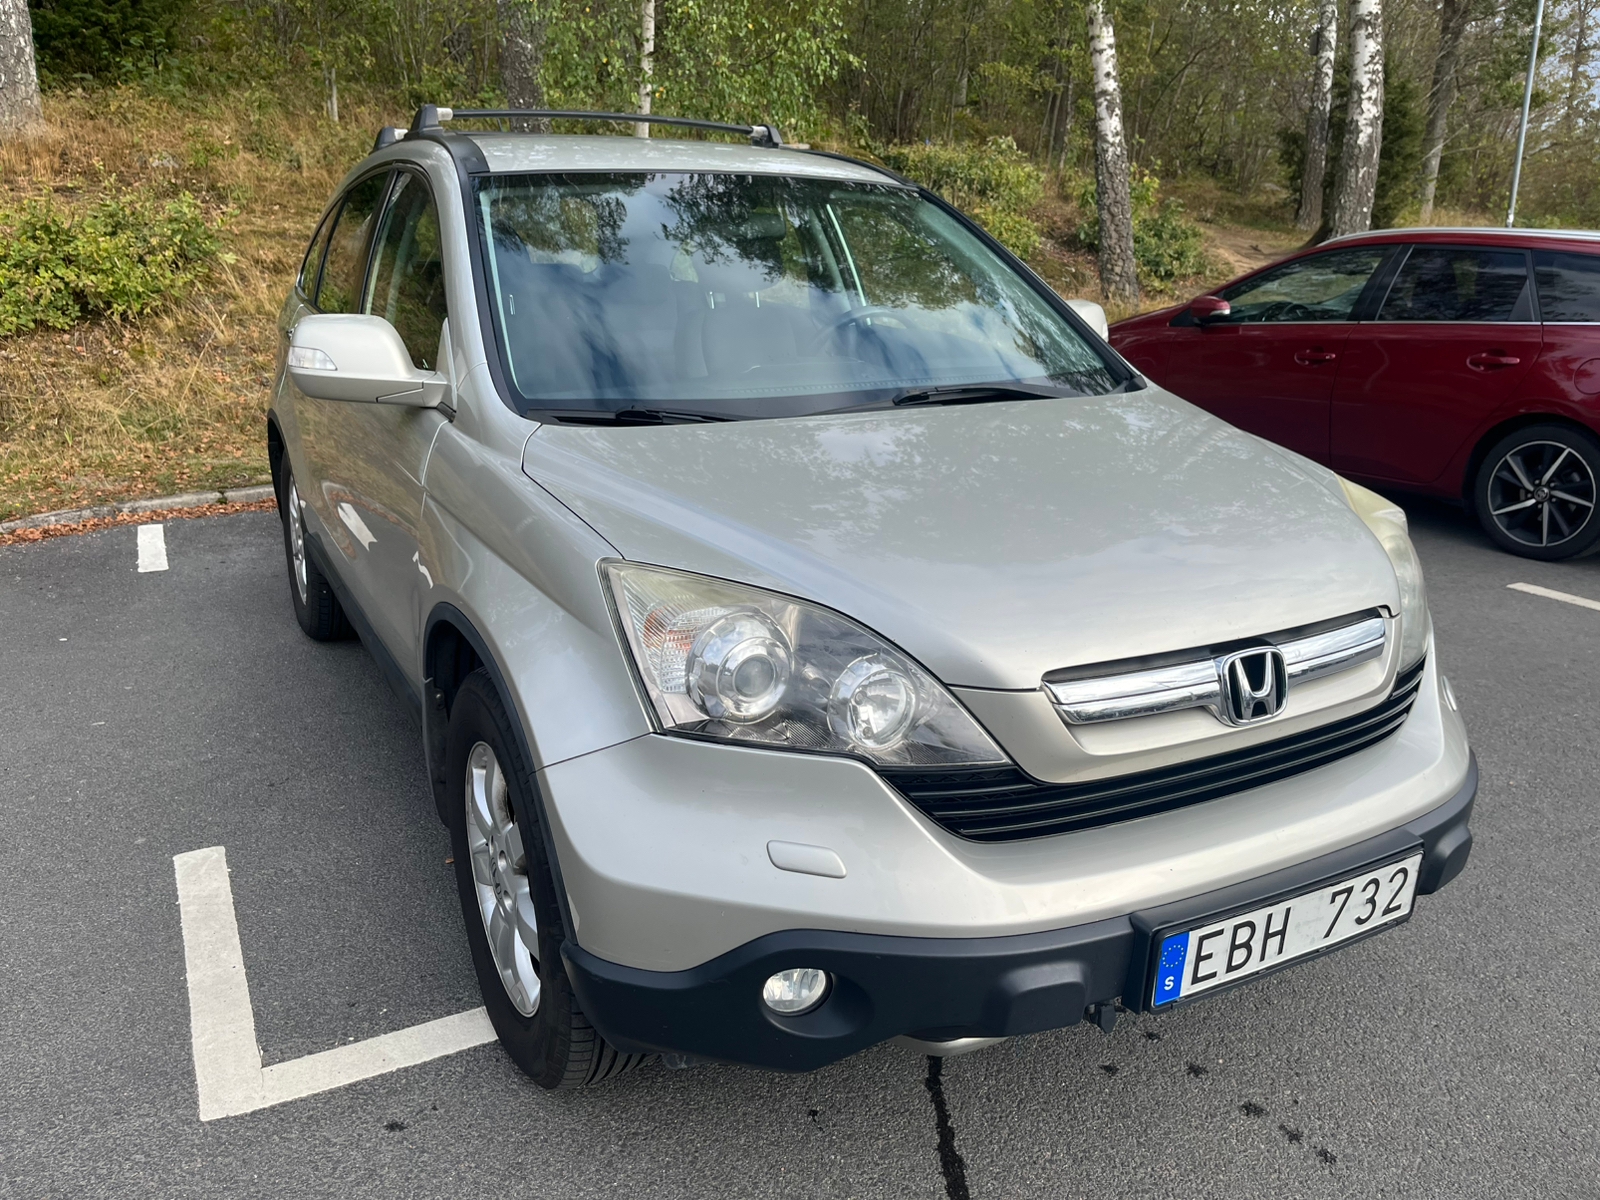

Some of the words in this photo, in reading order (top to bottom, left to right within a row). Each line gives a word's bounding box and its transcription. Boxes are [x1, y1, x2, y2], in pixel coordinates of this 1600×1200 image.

[1192, 908, 1291, 985] EBH
[1323, 867, 1409, 939] 732
[1163, 976, 1175, 991] S
